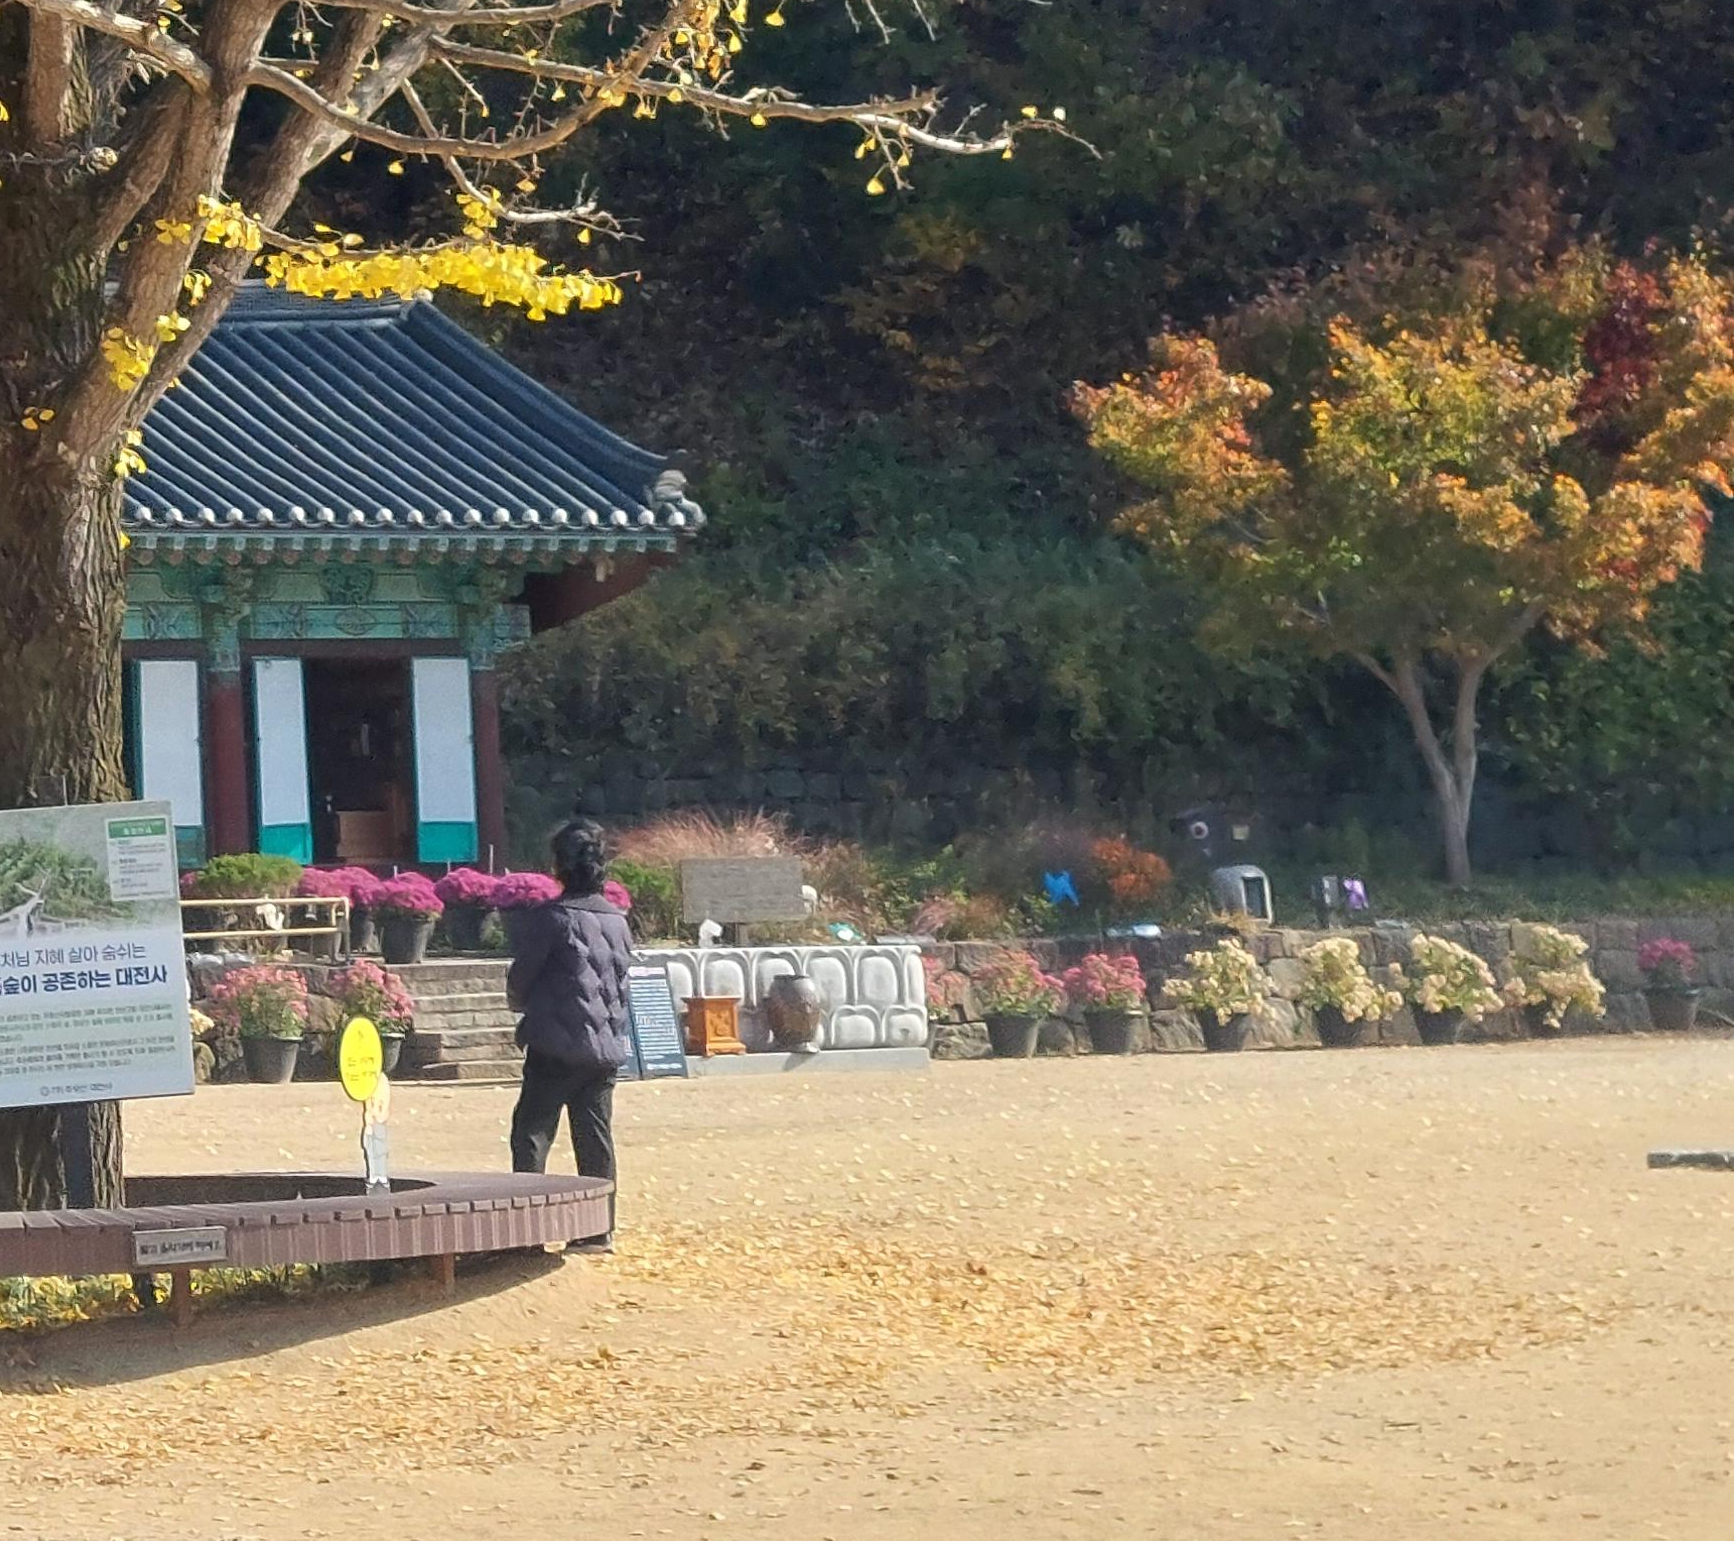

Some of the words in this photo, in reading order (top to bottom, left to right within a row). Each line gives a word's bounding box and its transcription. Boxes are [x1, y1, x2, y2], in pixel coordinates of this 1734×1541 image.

[34, 948, 65, 966] 지혜
[68, 946, 99, 964] 살아
[101, 943, 147, 962] 숨쉬는
[41, 970, 112, 993] 공존하는
[115, 964, 168, 986] 대전사
